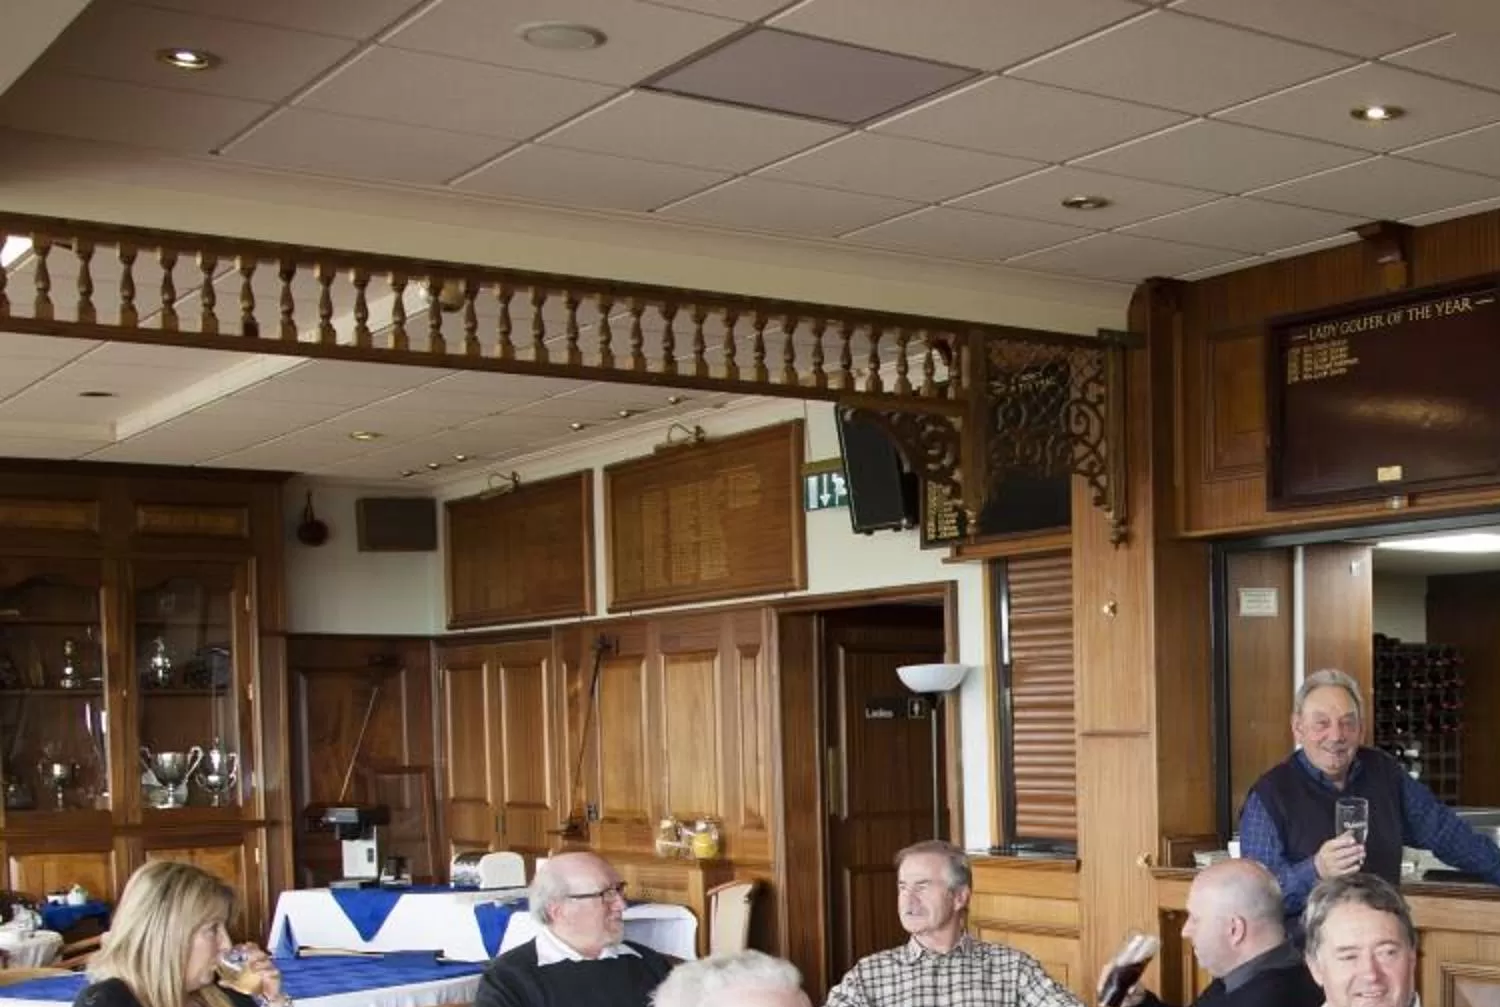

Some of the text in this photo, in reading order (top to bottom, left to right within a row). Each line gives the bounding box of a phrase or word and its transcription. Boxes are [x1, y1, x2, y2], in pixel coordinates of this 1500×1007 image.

[1340, 314, 1384, 334] GOLFER
[1387, 310, 1403, 326] OF
[1407, 306, 1431, 321] THE
[1435, 297, 1473, 317] YEAR
